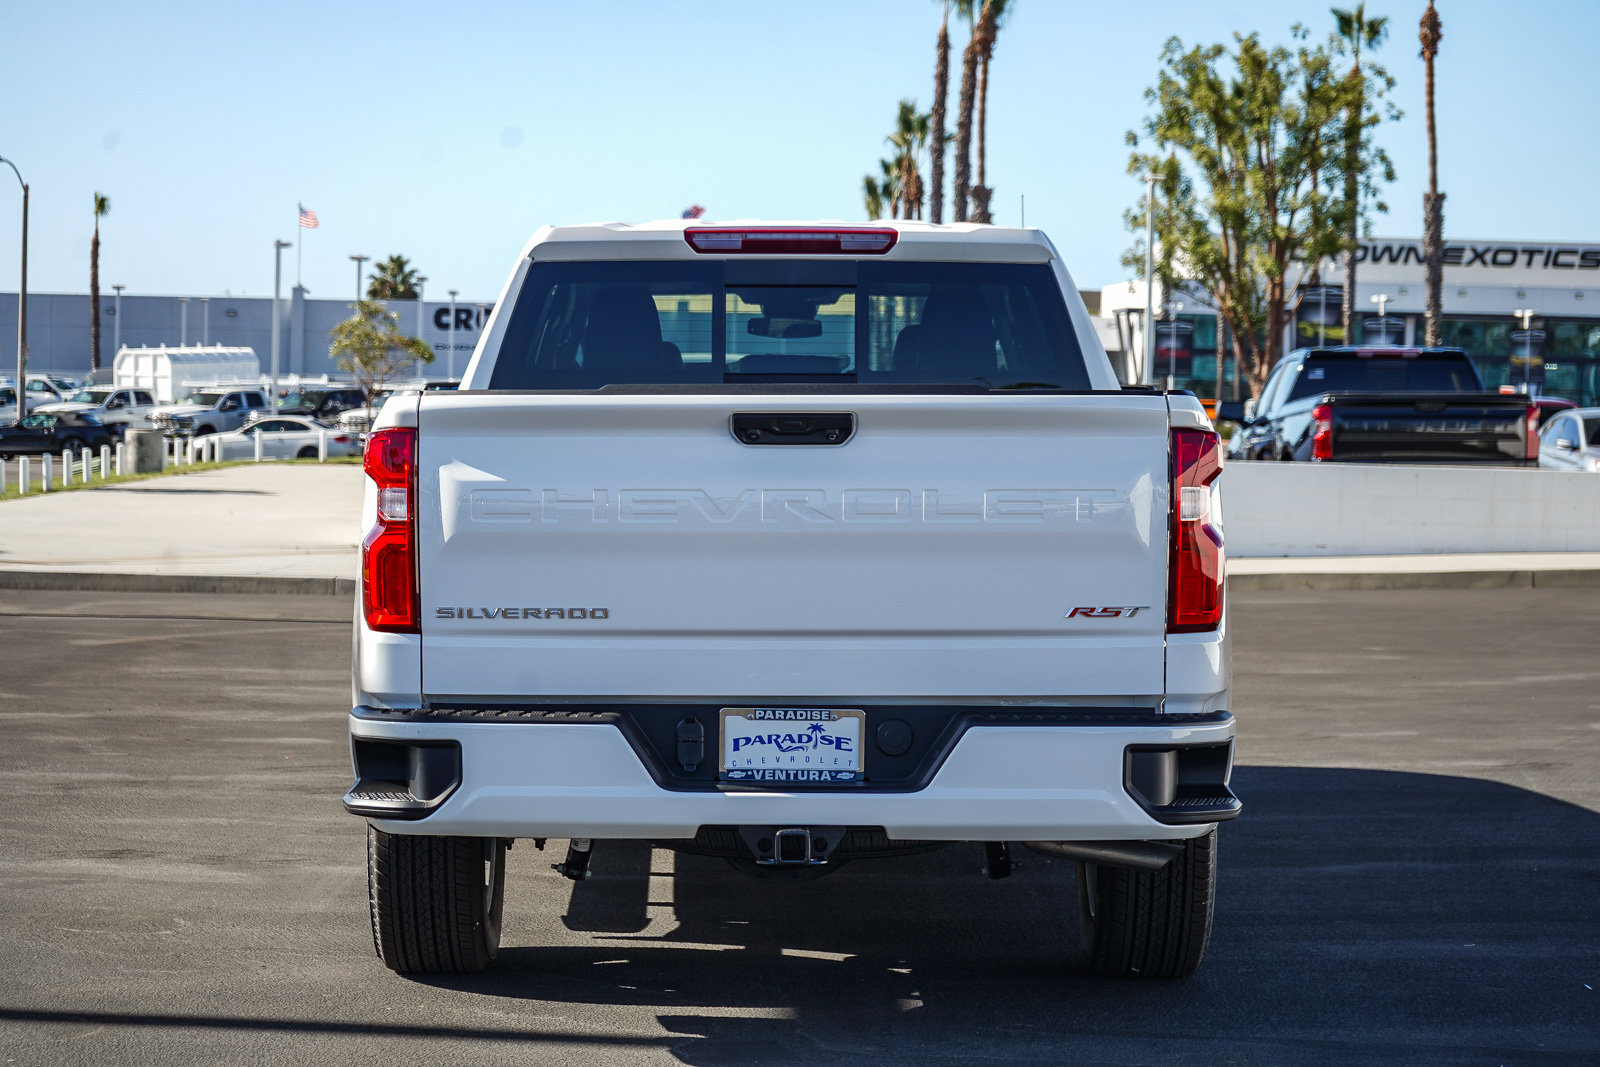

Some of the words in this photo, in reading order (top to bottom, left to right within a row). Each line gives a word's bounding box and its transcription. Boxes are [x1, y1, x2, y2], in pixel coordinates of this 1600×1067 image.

[1441, 246, 1600, 269] EXOTICS
[470, 488, 1116, 523] CHEVROLET
[435, 606, 609, 620] SILVERADO
[1064, 605, 1152, 619] RST
[755, 710, 830, 721] PARADISE
[732, 723, 853, 752] PARADISE
[732, 755, 853, 767] CHEVROLET
[753, 770, 832, 781] VENTURA
